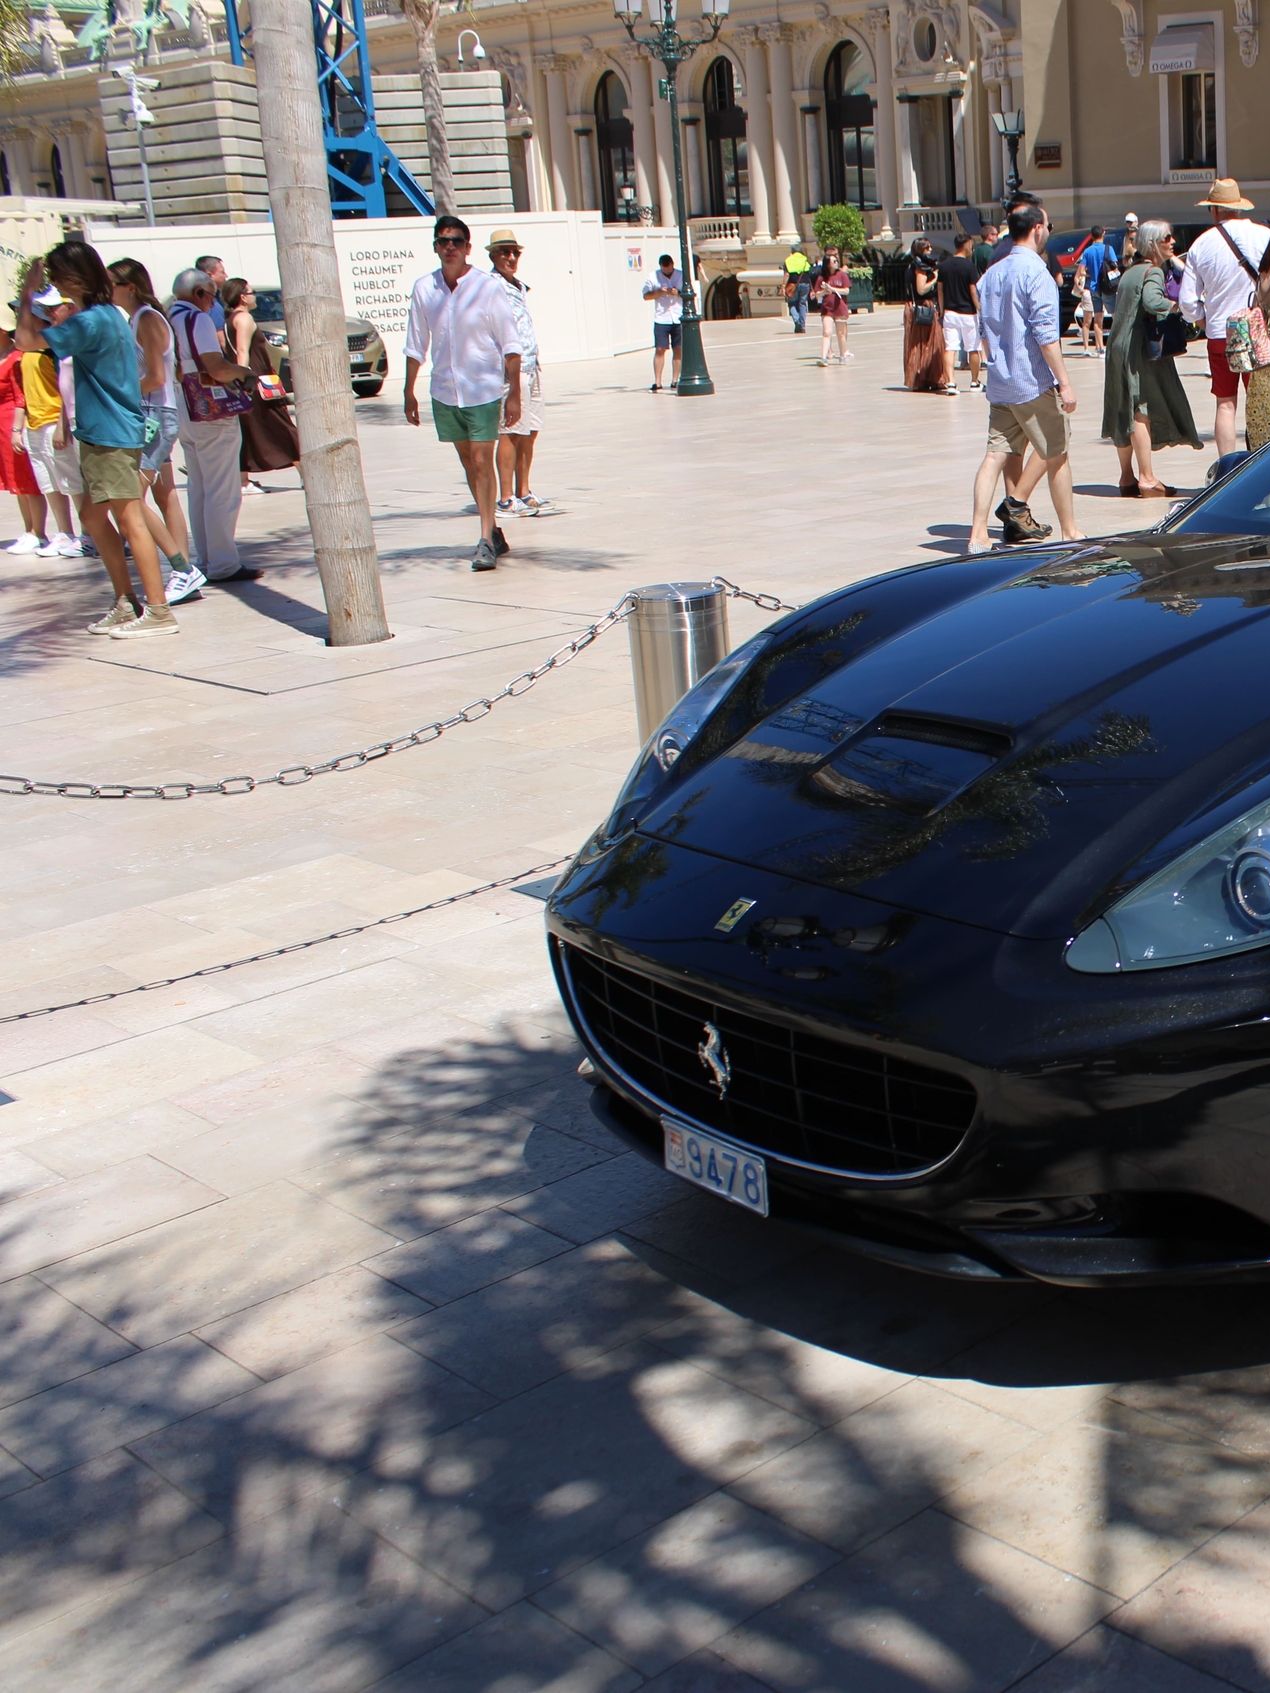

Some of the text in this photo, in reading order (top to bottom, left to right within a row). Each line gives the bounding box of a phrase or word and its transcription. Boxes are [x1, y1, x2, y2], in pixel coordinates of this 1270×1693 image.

[1160, 61, 1184, 71] OMEGA
[1180, 172, 1204, 181] OMEGA
[350, 249, 414, 261] LORO PIANA
[352, 264, 403, 276] CHAUMET
[353, 279, 395, 291] HUBLOT
[355, 293, 402, 305] RICHARD
[686, 1137, 761, 1205] 9478
